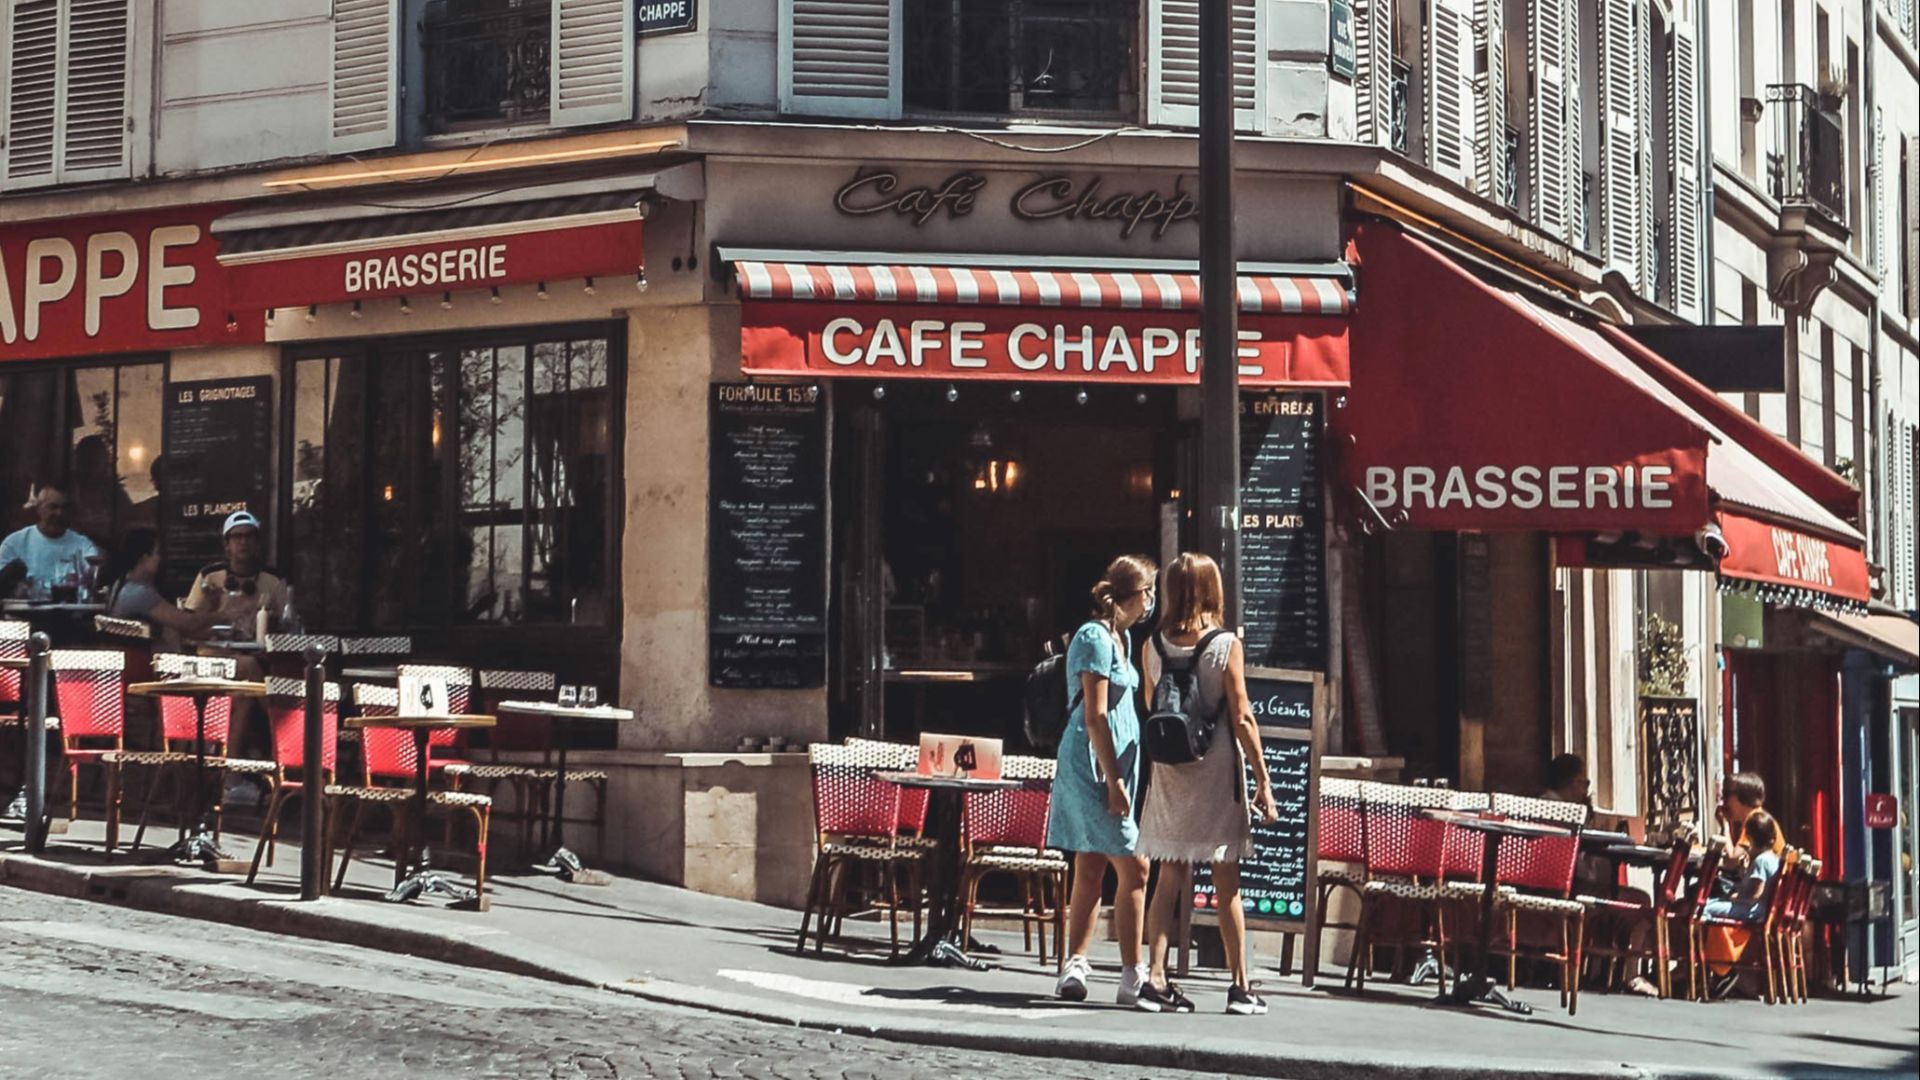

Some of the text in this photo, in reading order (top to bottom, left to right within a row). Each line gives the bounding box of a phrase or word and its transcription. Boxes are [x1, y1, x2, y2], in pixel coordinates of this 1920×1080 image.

[639, 1, 686, 22] CHAPPE
[836, 172, 1200, 238] Café Chapp
[345, 244, 507, 293] BRASSERIE
[821, 317, 988, 367] CAFE
[179, 390, 193, 403] LES
[719, 386, 782, 401] FORMULE
[1365, 466, 1673, 508] BRASSERIE
[1240, 515, 1304, 527] ES PLATS
